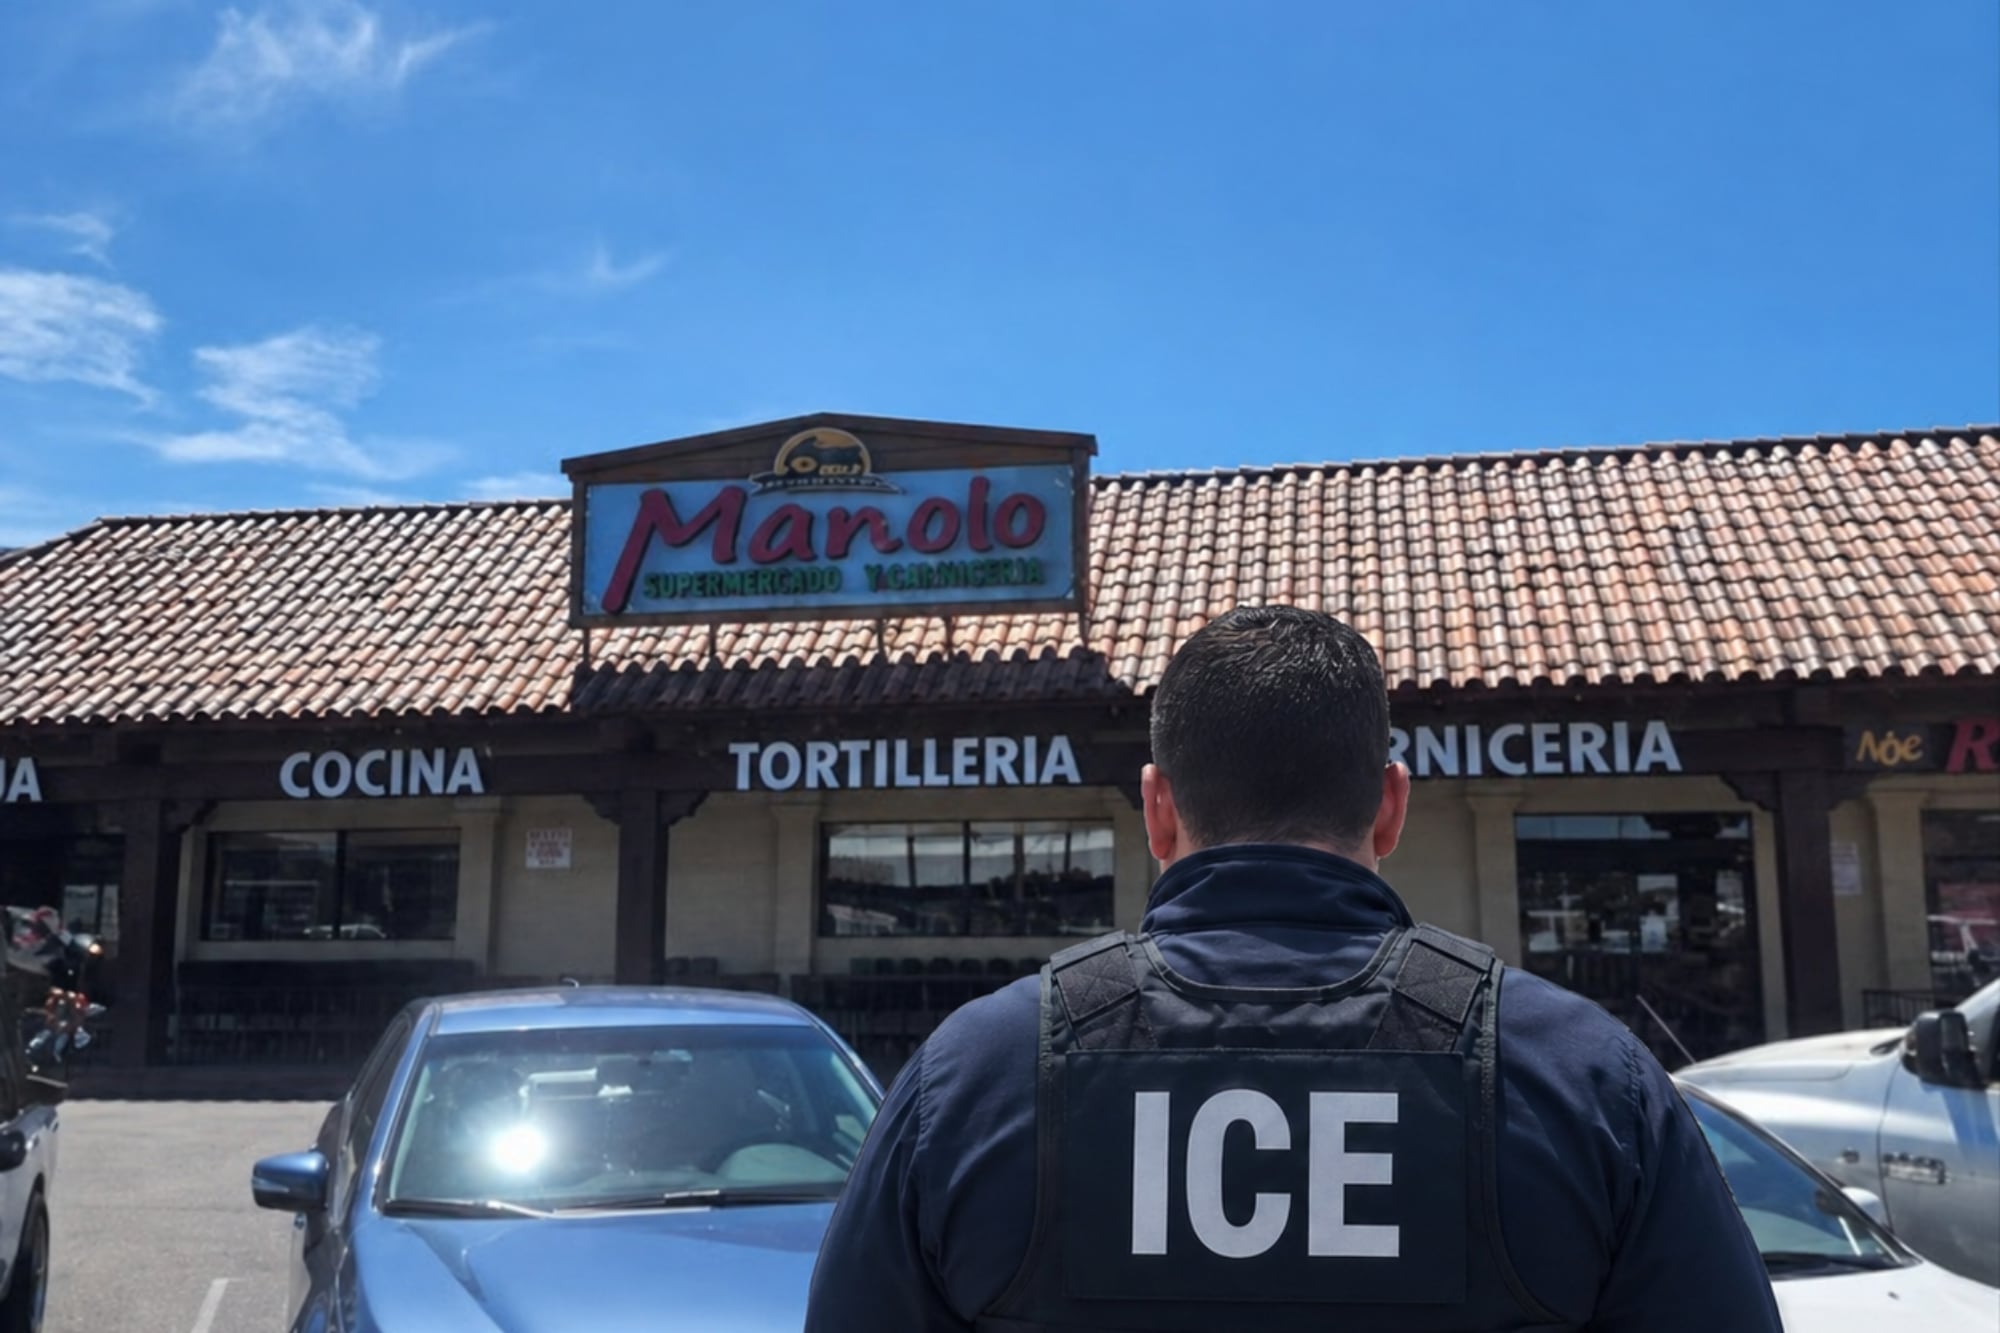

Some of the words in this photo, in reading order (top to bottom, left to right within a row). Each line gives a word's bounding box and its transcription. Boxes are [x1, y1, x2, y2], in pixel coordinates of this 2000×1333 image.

[602, 475, 1046, 614] Manolo
[643, 565, 842, 599] SUPERMERCADO
[864, 564, 883, 593] Y
[279, 747, 484, 799] COCINA
[729, 735, 1082, 791] TORTILLERIA
[1131, 1089, 1400, 1259] ICE
